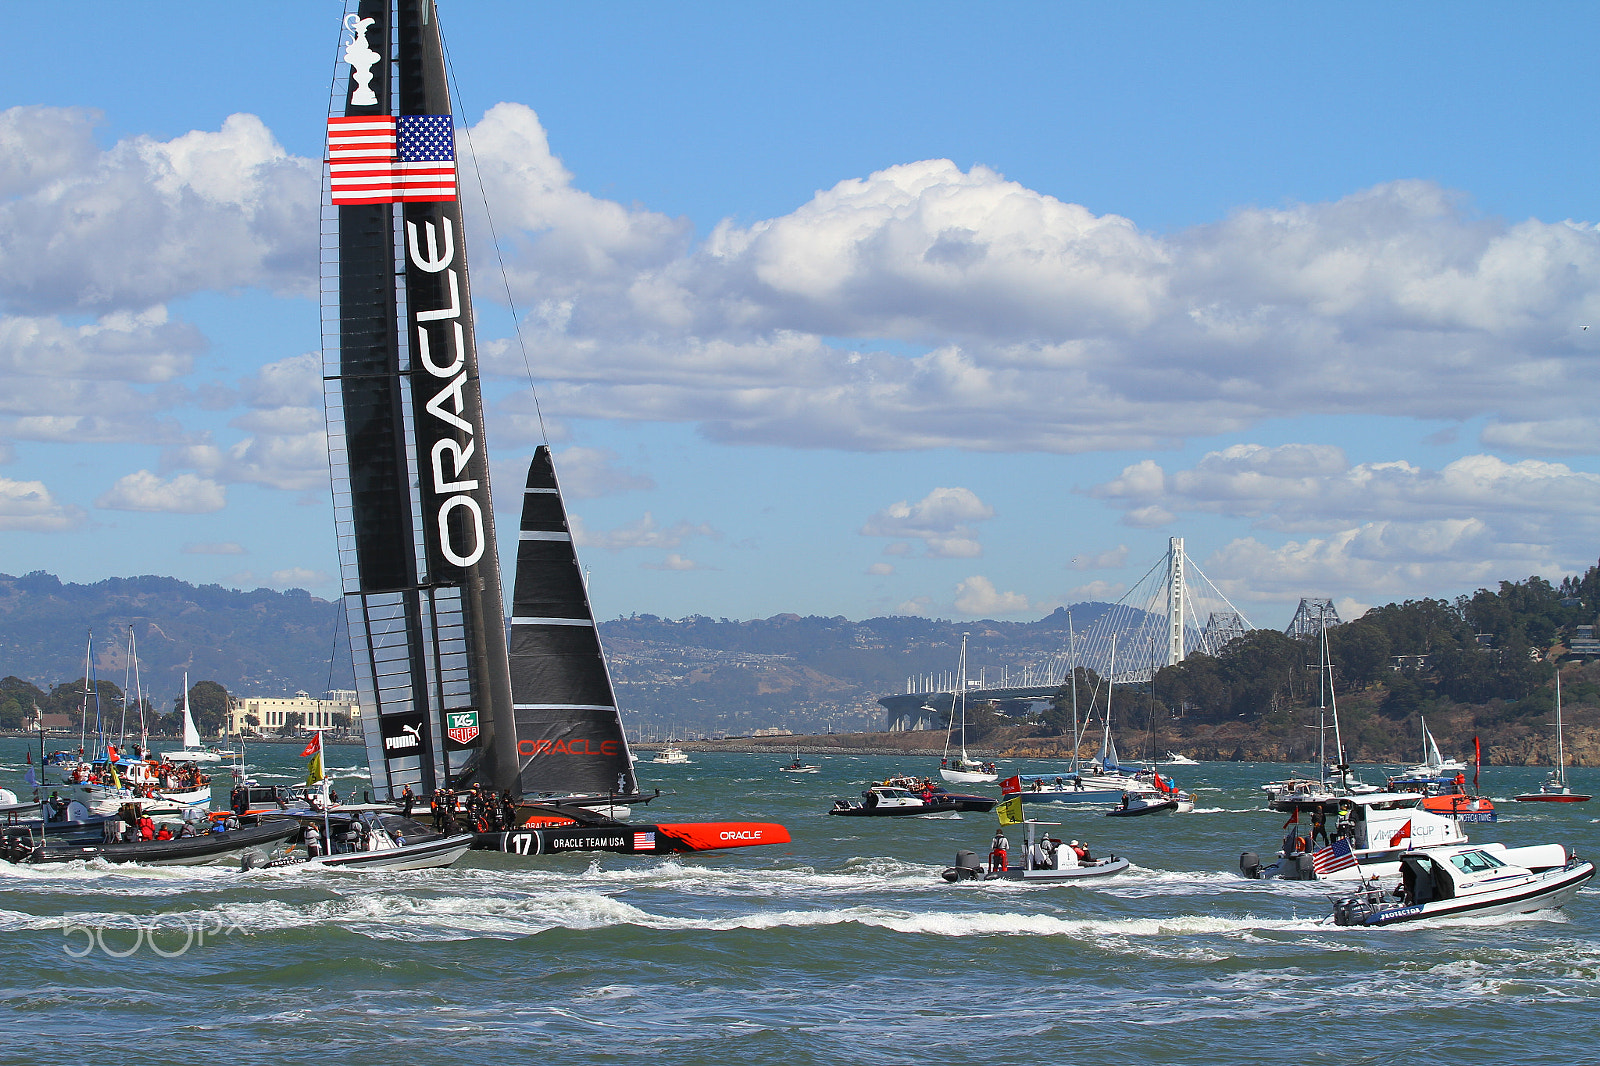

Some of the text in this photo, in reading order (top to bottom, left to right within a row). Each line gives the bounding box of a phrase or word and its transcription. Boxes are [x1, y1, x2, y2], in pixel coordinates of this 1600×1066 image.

[406, 215, 485, 568] ORACLE
[451, 713, 474, 728] TAG
[450, 727, 477, 743] HEUER
[517, 738, 619, 756] ORACLE
[720, 830, 763, 840] ORACLE
[1416, 825, 1435, 836] CUP
[553, 837, 625, 849] ORACLE TEAM USA
[1379, 907, 1421, 921] PROTECTOR
